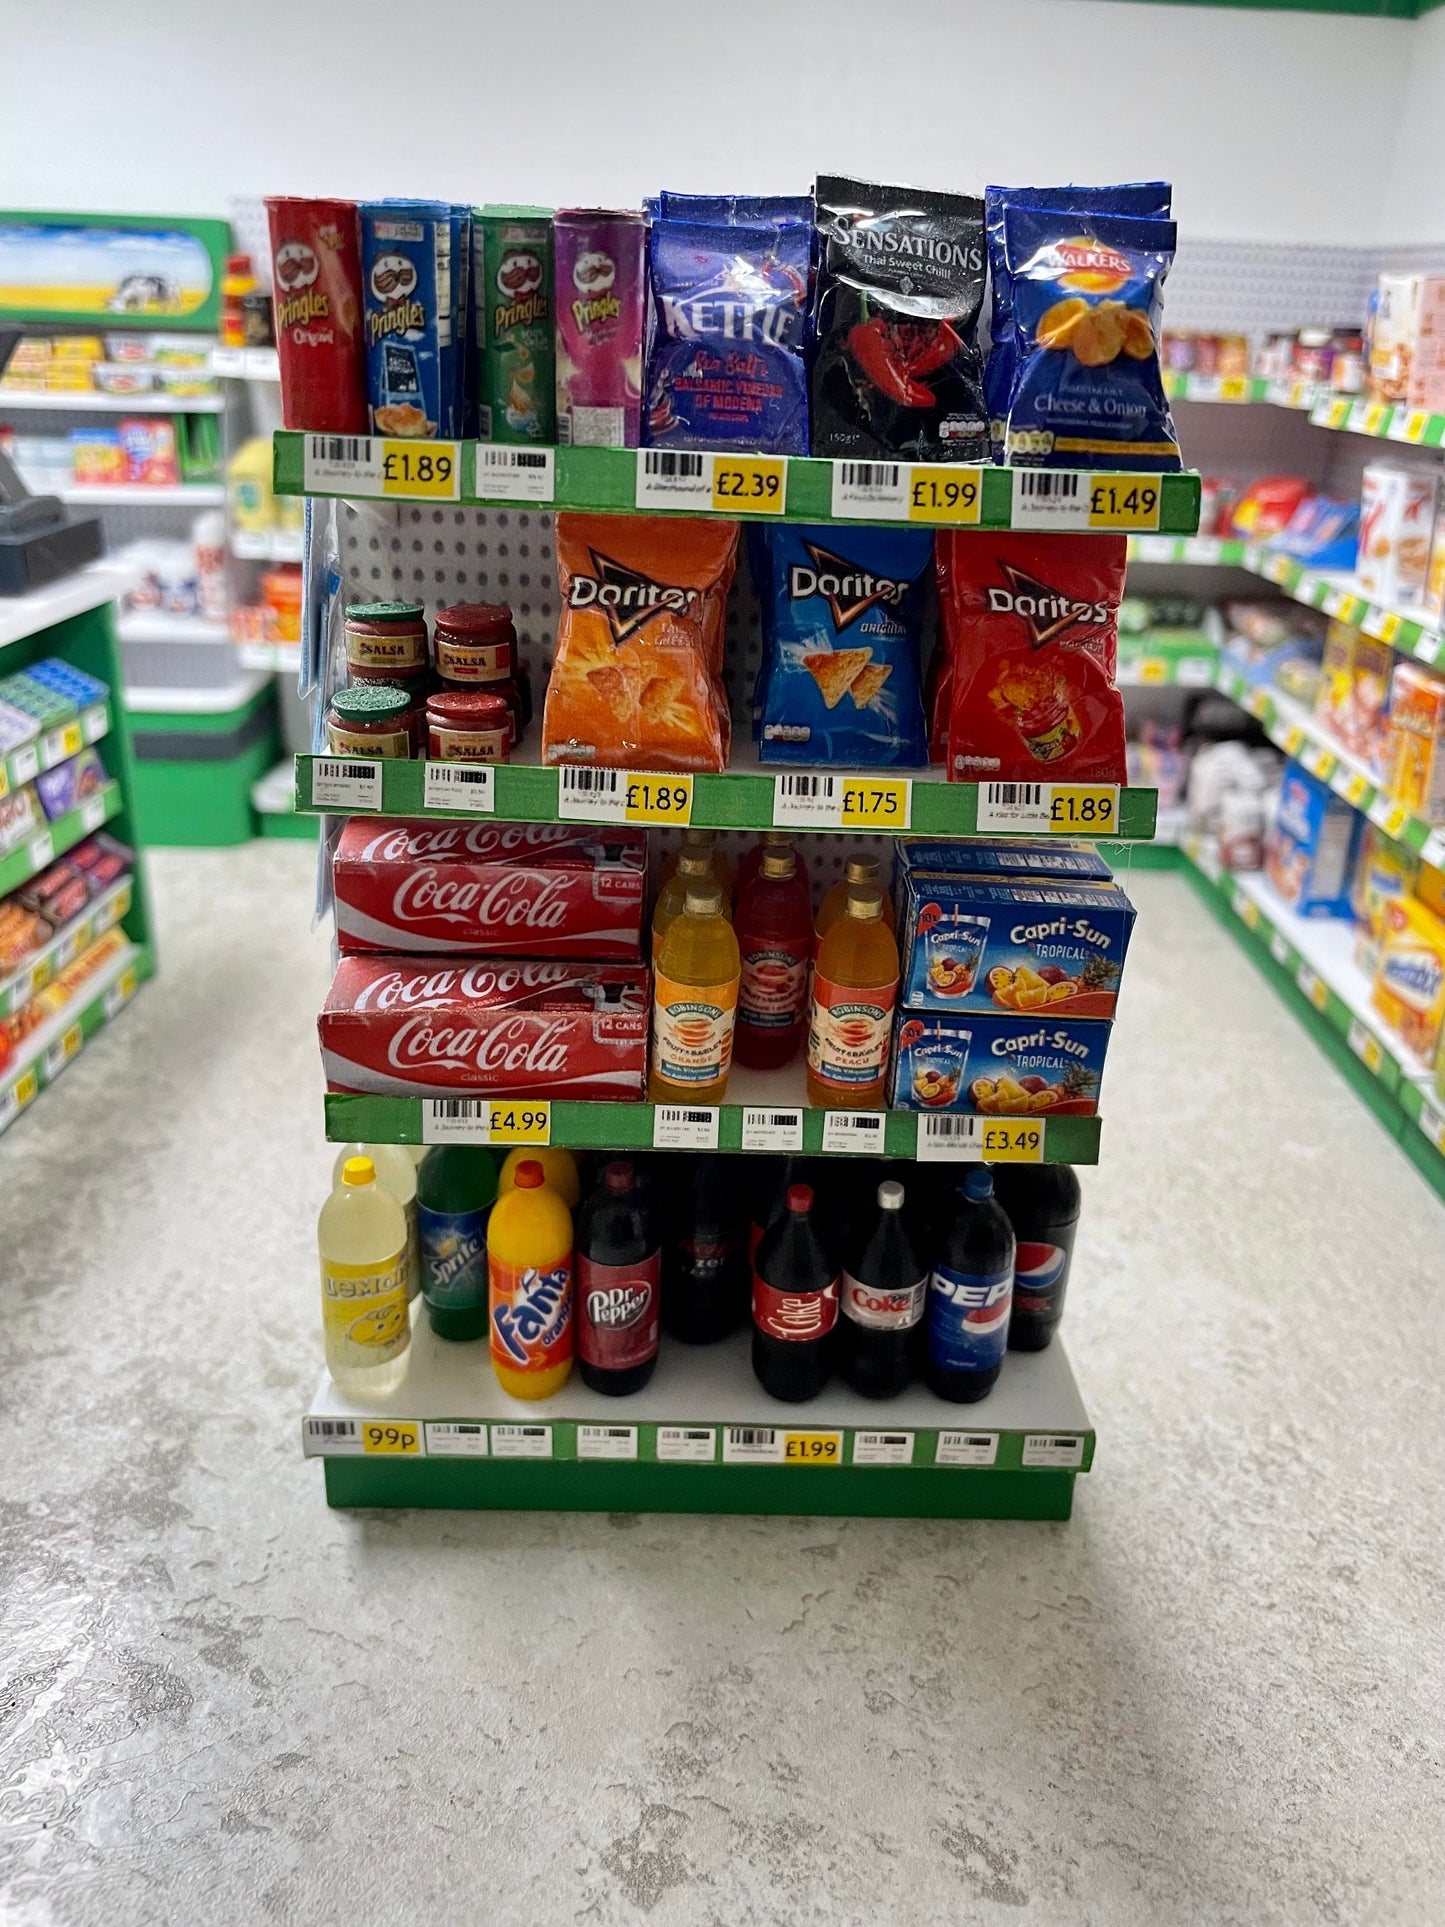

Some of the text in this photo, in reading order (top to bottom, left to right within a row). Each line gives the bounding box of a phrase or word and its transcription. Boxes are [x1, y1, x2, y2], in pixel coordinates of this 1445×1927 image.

[832, 216, 983, 271] SENSATIONS
[864, 254, 887, 265] Thai
[889, 257, 923, 271] Sweet
[1048, 251, 1132, 272] WALKERS
[278, 289, 329, 337] Pringles
[370, 302, 425, 345] Pringles
[495, 297, 548, 335] Pringles
[572, 295, 621, 331] Pringles
[1033, 393, 1147, 418] Cheese & Onion
[383, 454, 452, 482] £1.89
[717, 472, 779, 497] £2.39
[912, 481, 977, 508] £1.99
[1091, 487, 1158, 515] £1.49
[791, 566, 909, 606] Doritos
[988, 588, 1109, 624] Doritos
[365, 645, 405, 656] SALSA
[449, 656, 486, 667] SALSA
[344, 745, 384, 756] SALSA
[454, 745, 495, 756] SALSA
[625, 785, 688, 811] £1.89
[843, 791, 897, 813] £1.75
[1050, 797, 1112, 821] £1.89
[361, 824, 571, 862] Coca-Cola
[600, 878, 642, 890] 12 CANS
[393, 867, 580, 930] Coca-Cola
[931, 931, 981, 946] Capri-Sun
[1010, 915, 1112, 950] Capri-Sun
[1035, 944, 1087, 960] TROPICAL
[354, 963, 571, 1010] Coca-Cola
[668, 1003, 722, 1019] ROBINSONS
[831, 1004, 886, 1020] ROBINSONS
[600, 1020, 643, 1031] 12 CANS
[387, 1015, 579, 1072] Coca-Cola
[914, 1043, 963, 1059] Capri-Sun
[990, 1030, 1090, 1059] Capri-Sun
[670, 1053, 713, 1064] ORANGE
[834, 1055, 871, 1065] PEACH
[1016, 1054, 1066, 1069] TROPICAL
[490, 1111, 547, 1131] £4.99
[985, 1131, 1040, 1150] £3.49
[430, 1237, 481, 1286] Sprite
[593, 1289, 648, 1325] Pepper
[609, 1288, 634, 1306] Dr
[852, 1288, 909, 1313] Coke
[494, 1268, 570, 1365] Fanta
[767, 1296, 822, 1334] Coke
[368, 1428, 416, 1449] 99p
[786, 1441, 837, 1457] £1.99
